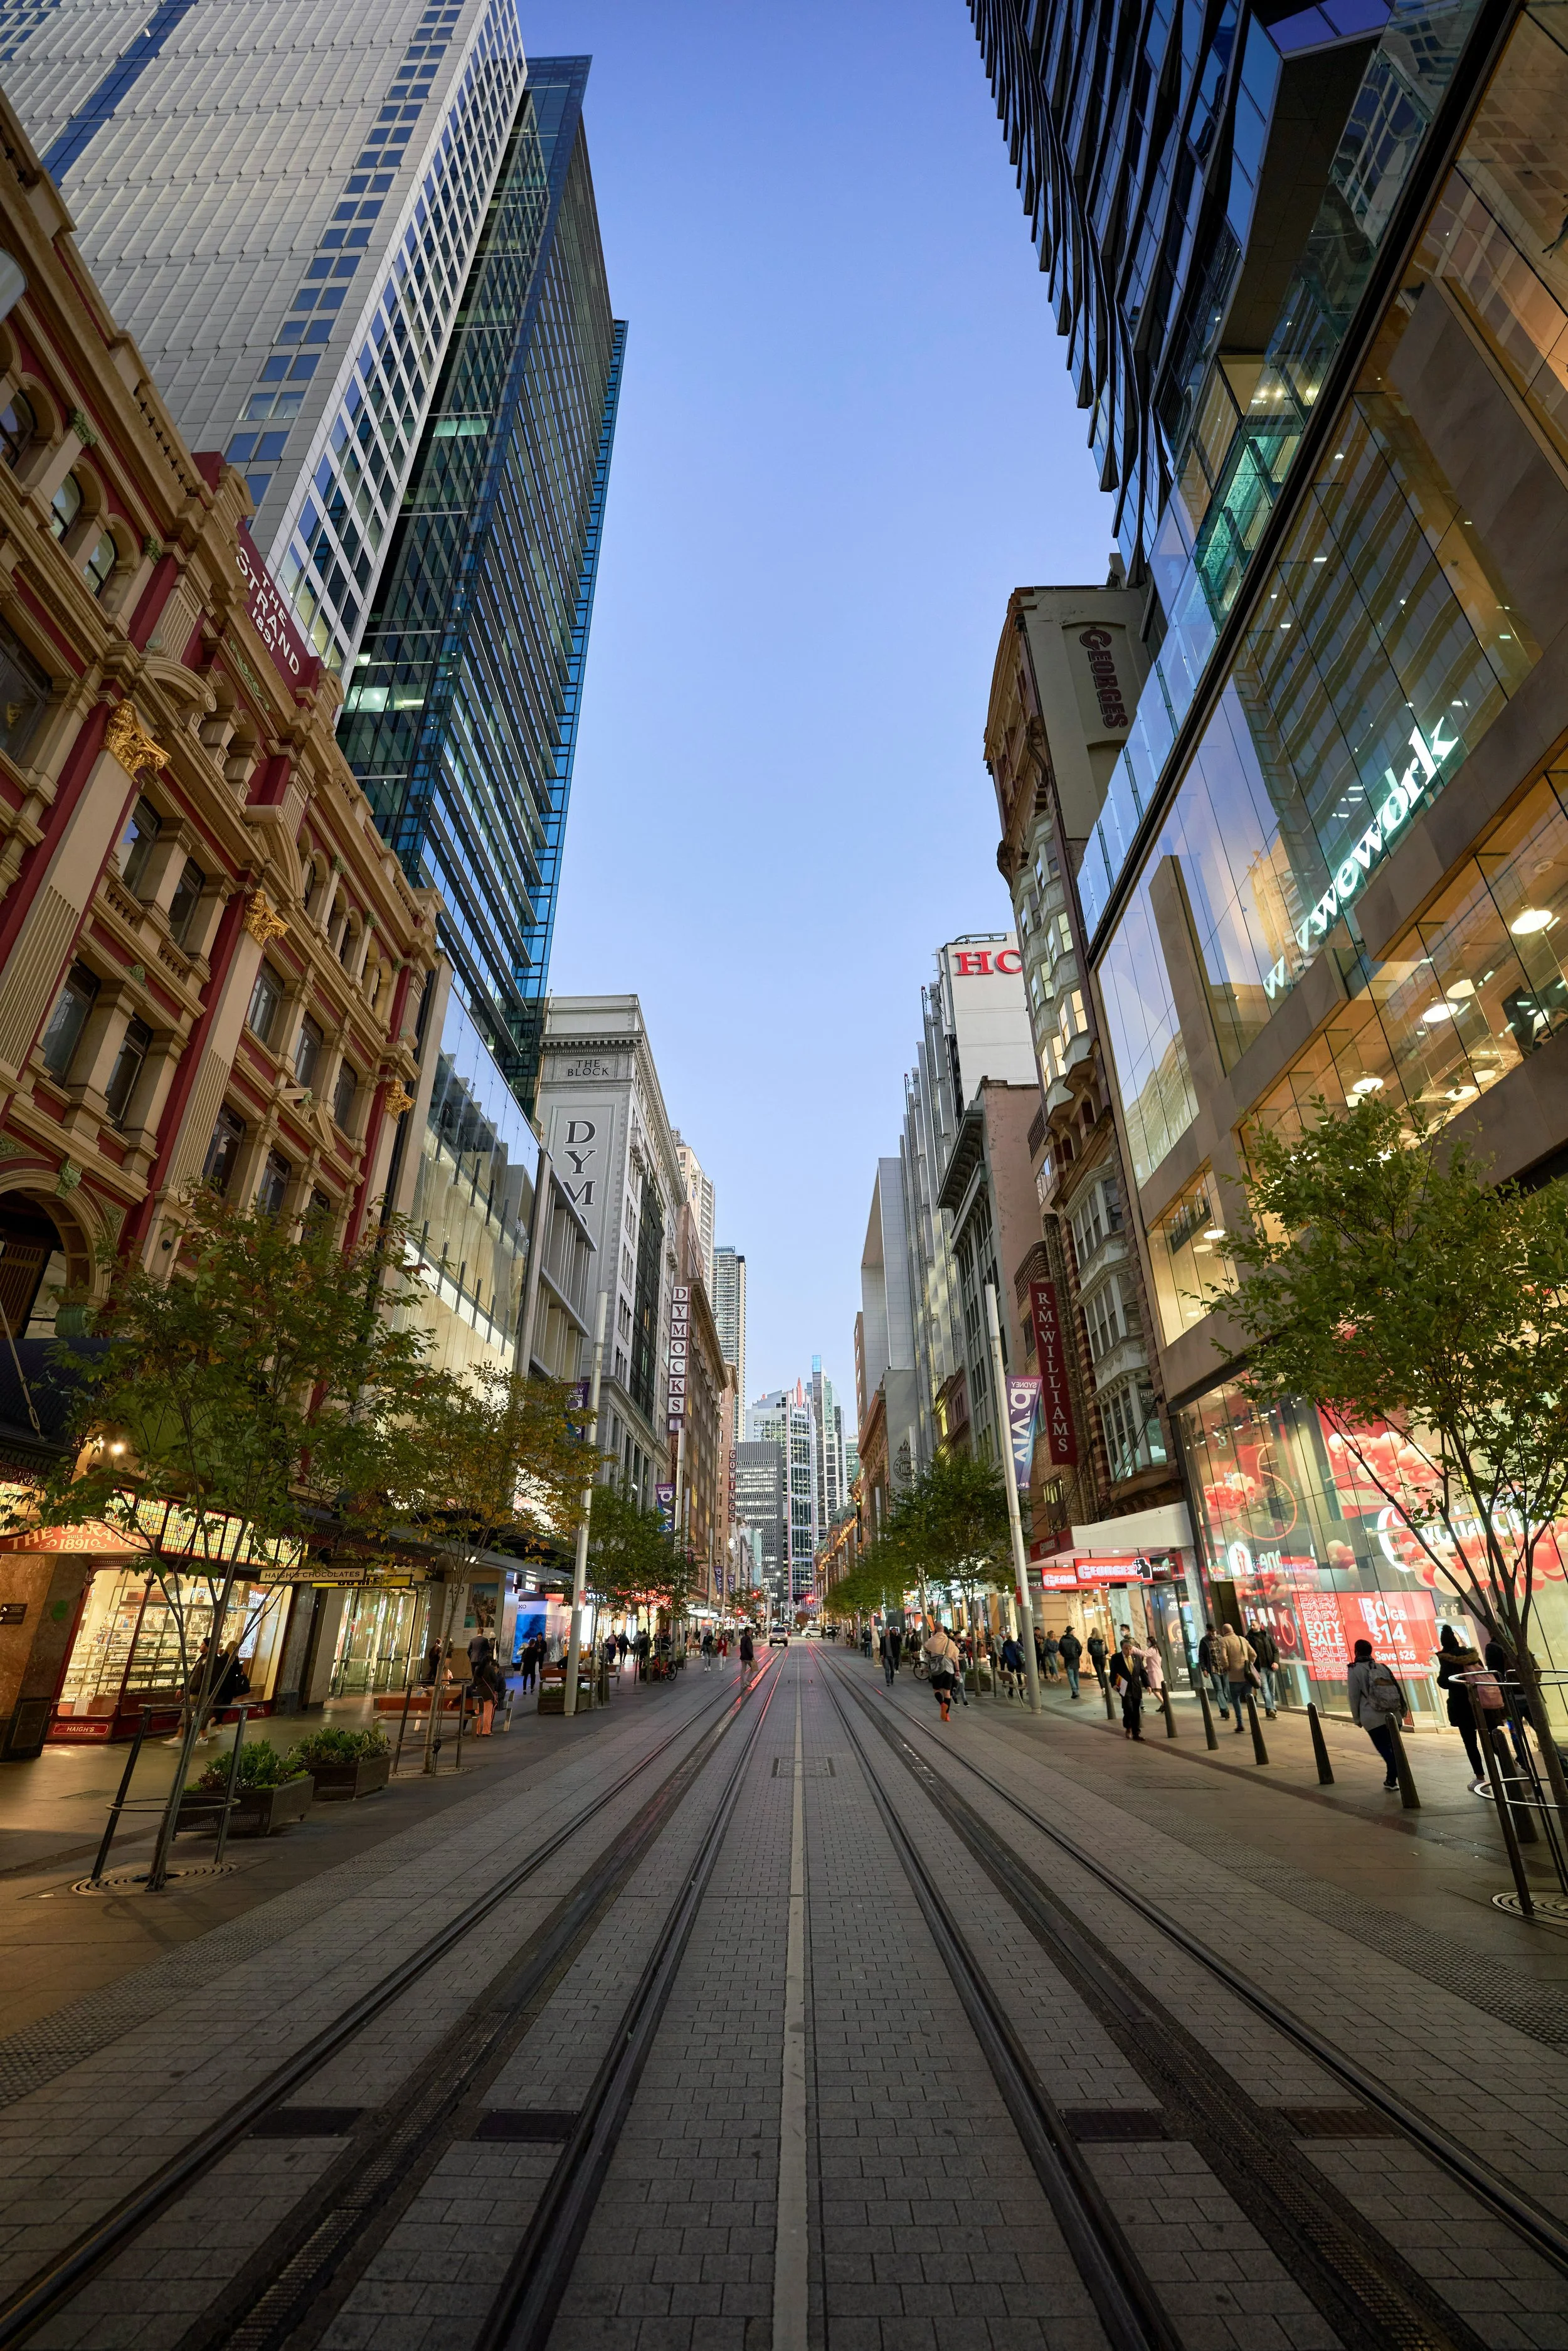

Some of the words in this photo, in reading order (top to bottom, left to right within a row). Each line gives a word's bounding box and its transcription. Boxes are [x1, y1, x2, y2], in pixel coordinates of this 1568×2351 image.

[262, 571, 288, 627] THE
[236, 547, 300, 676] STRAND
[252, 607, 275, 652] 1891
[1079, 629, 1128, 728] GEORGES
[567, 1067, 610, 1076] BLOCK
[576, 1059, 600, 1068] THE
[563, 1120, 596, 1226] DYM
[671, 1288, 687, 1411] DYMOCKS
[728, 1450, 736, 1522] GOWINGS
[8, 1526, 53, 1550] THE
[59, 1539, 88, 1549] 1891
[1078, 1565, 1136, 1579] GEORGES
[1305, 1621, 1340, 1634] EOFY
[1308, 1633, 1345, 1647] SALE
[1374, 1650, 1398, 1662] Save
[1399, 1649, 1416, 1661] $26
